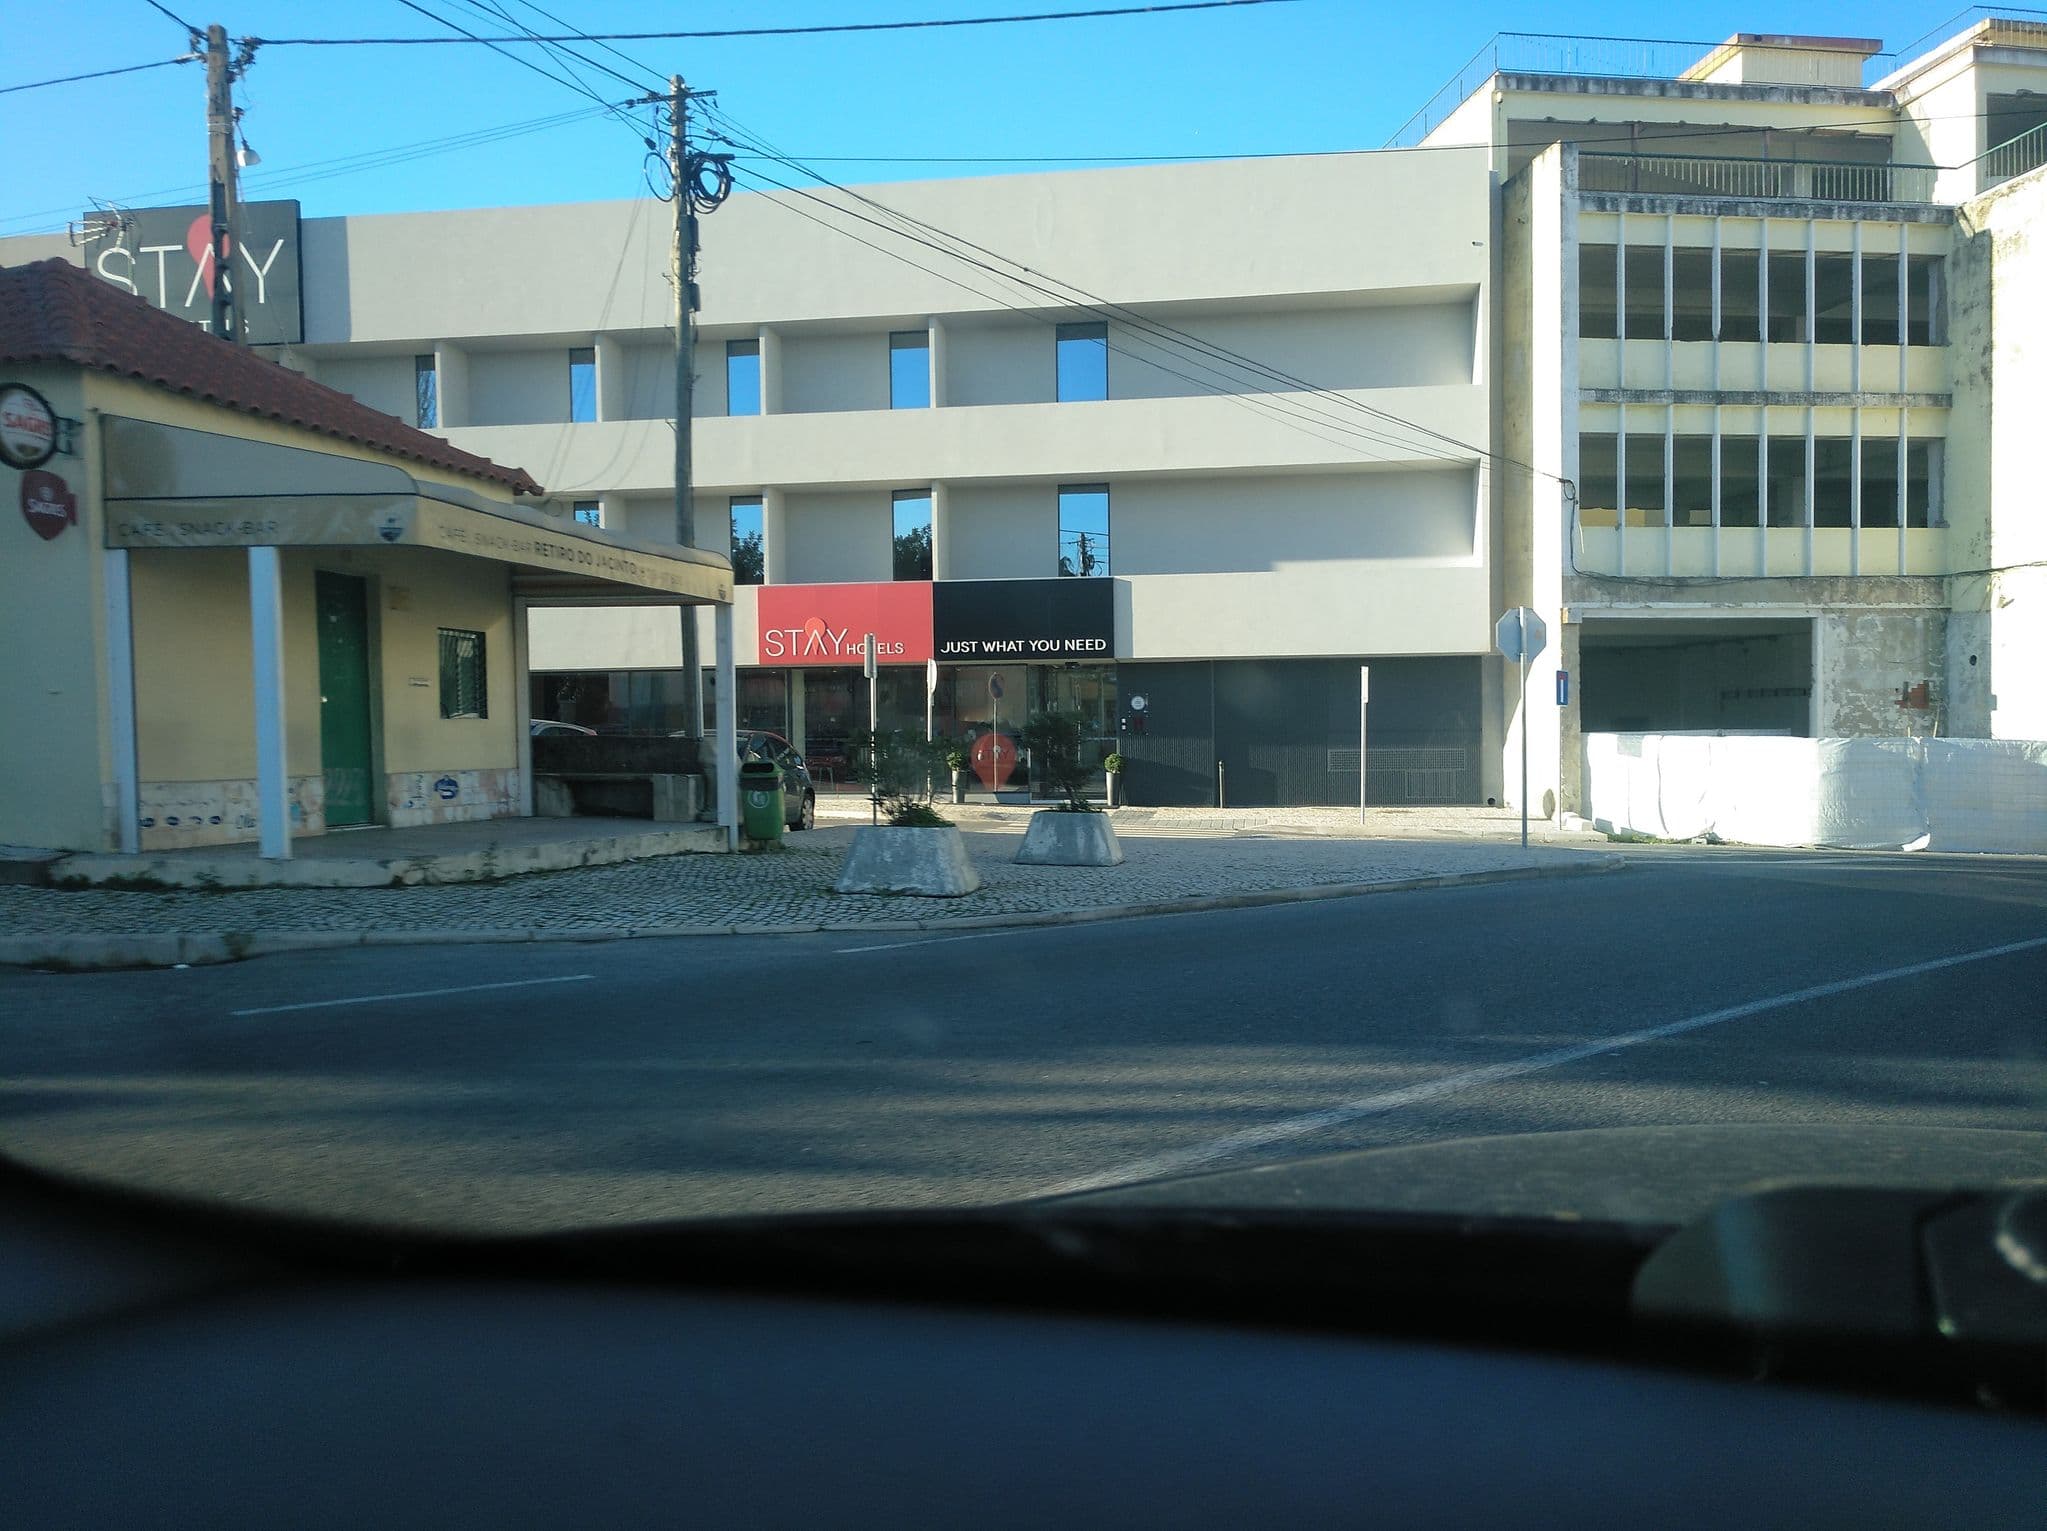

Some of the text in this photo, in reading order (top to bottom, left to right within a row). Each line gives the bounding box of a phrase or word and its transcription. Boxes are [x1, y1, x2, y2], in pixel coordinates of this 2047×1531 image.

[534, 541, 575, 563] RETIRO
[577, 549, 593, 566] DO
[595, 554, 638, 576] JACINTO
[764, 627, 905, 657] STAY HOELS
[940, 638, 1107, 654] JUST WHAT YOU NEED
